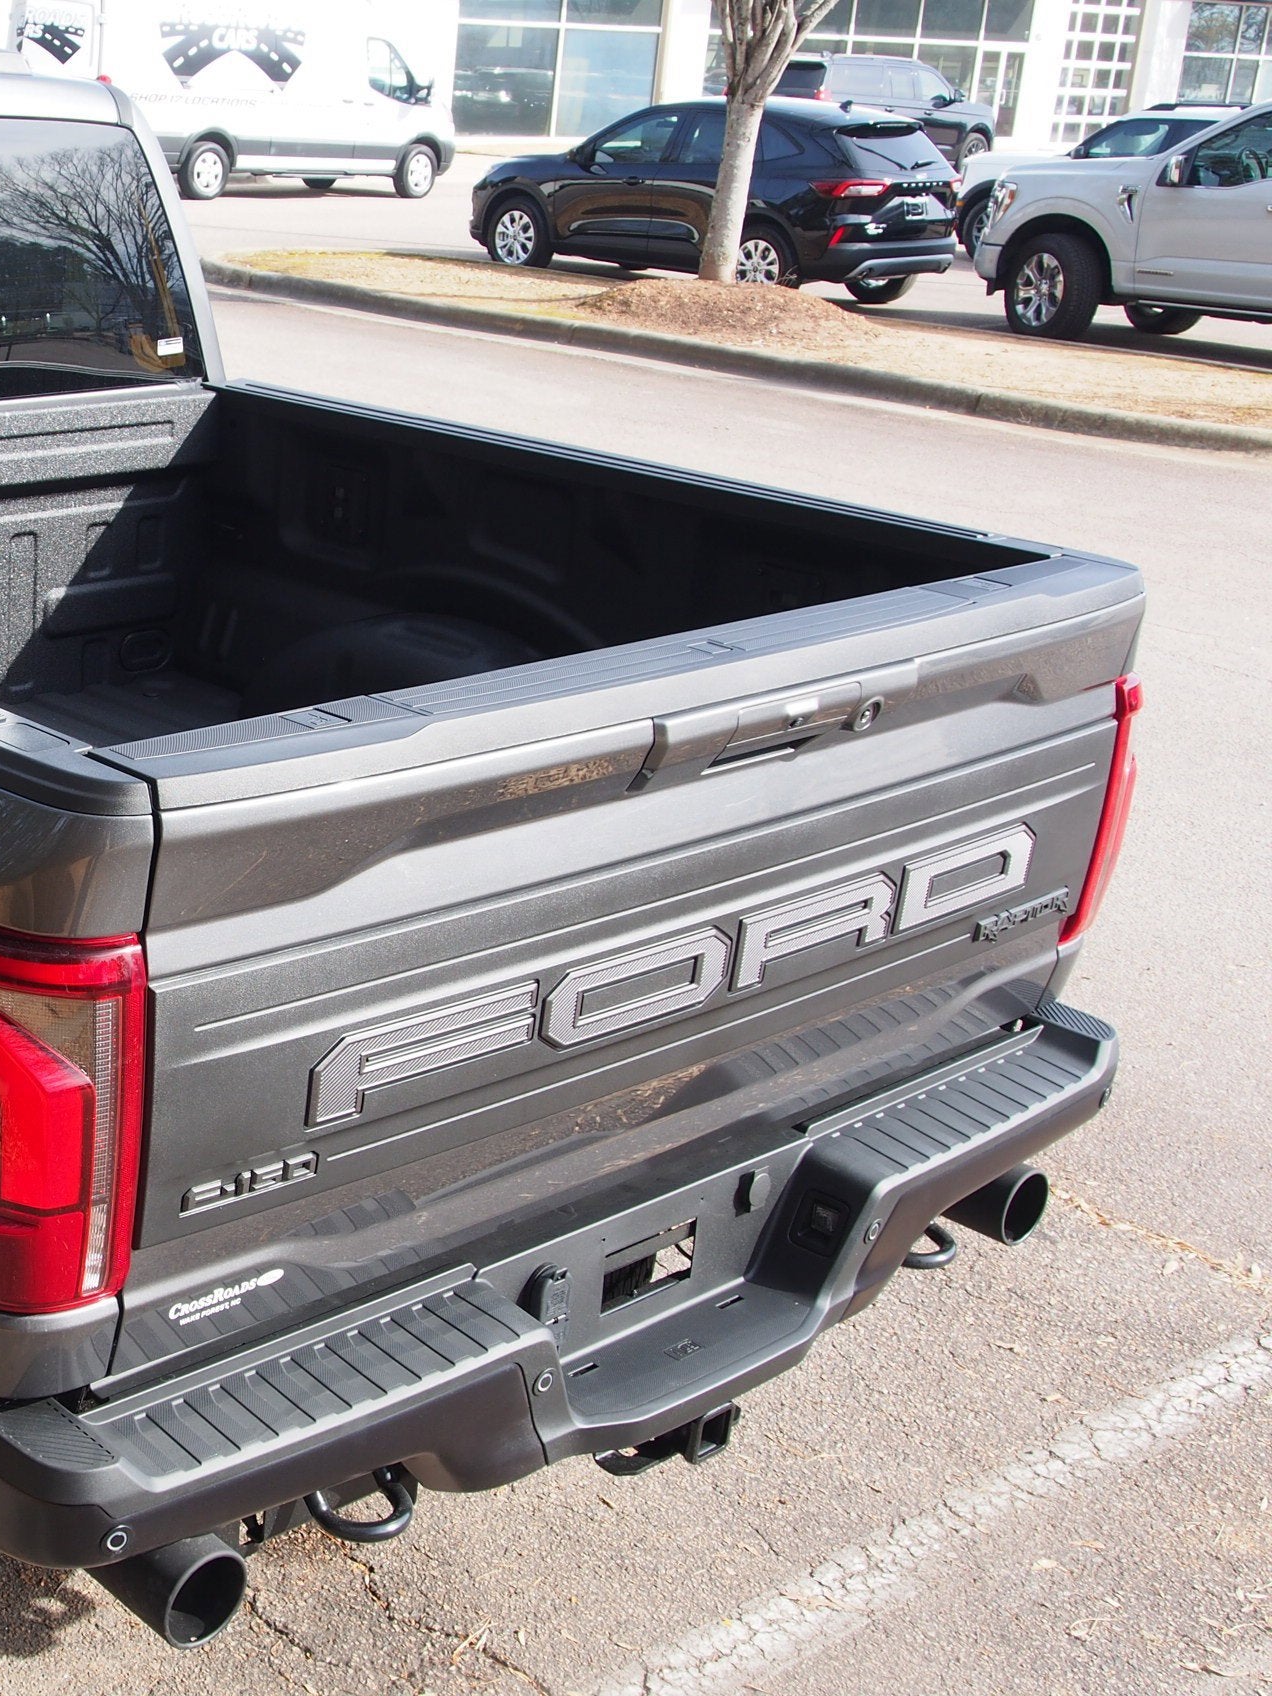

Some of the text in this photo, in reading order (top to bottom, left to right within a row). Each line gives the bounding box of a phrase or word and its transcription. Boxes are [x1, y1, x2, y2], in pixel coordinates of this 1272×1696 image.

[211, 26, 258, 50] CARS
[130, 92, 168, 104] SHOP
[184, 94, 258, 108] LOCATIONS
[972, 885, 1069, 944] RAPTOR
[304, 821, 1036, 1131] FORD
[178, 1150, 320, 1219] F-150
